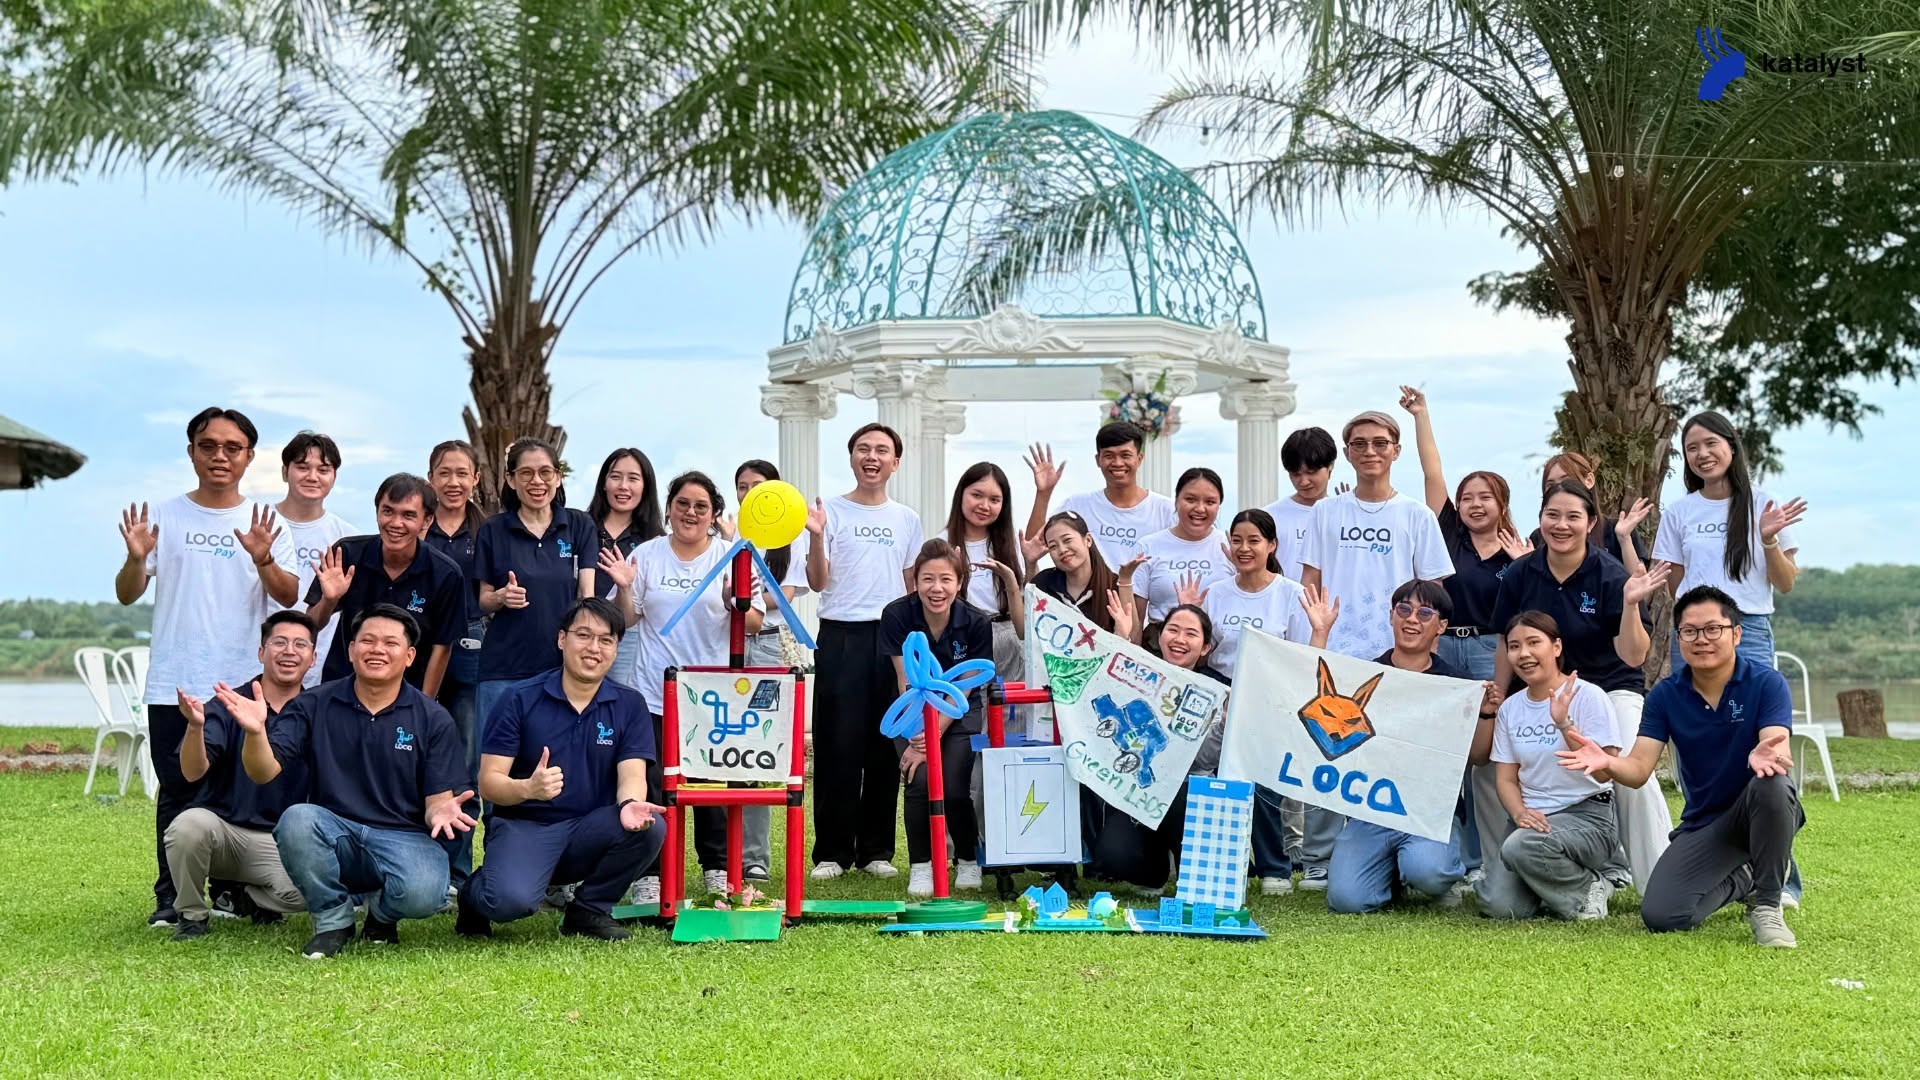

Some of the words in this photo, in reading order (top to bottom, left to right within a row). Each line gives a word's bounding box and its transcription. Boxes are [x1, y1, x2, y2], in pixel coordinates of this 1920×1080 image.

[1697, 523, 1729, 533] LOC
[878, 537, 895, 547] Pay
[1120, 538, 1137, 547] Pay
[214, 548, 236, 558] Pay
[1369, 543, 1393, 555] Pay
[1124, 660, 1158, 684] VISA
[1538, 736, 1558, 745] Pay
[1066, 741, 1123, 790] Green
[1278, 752, 1408, 816] LOCA
